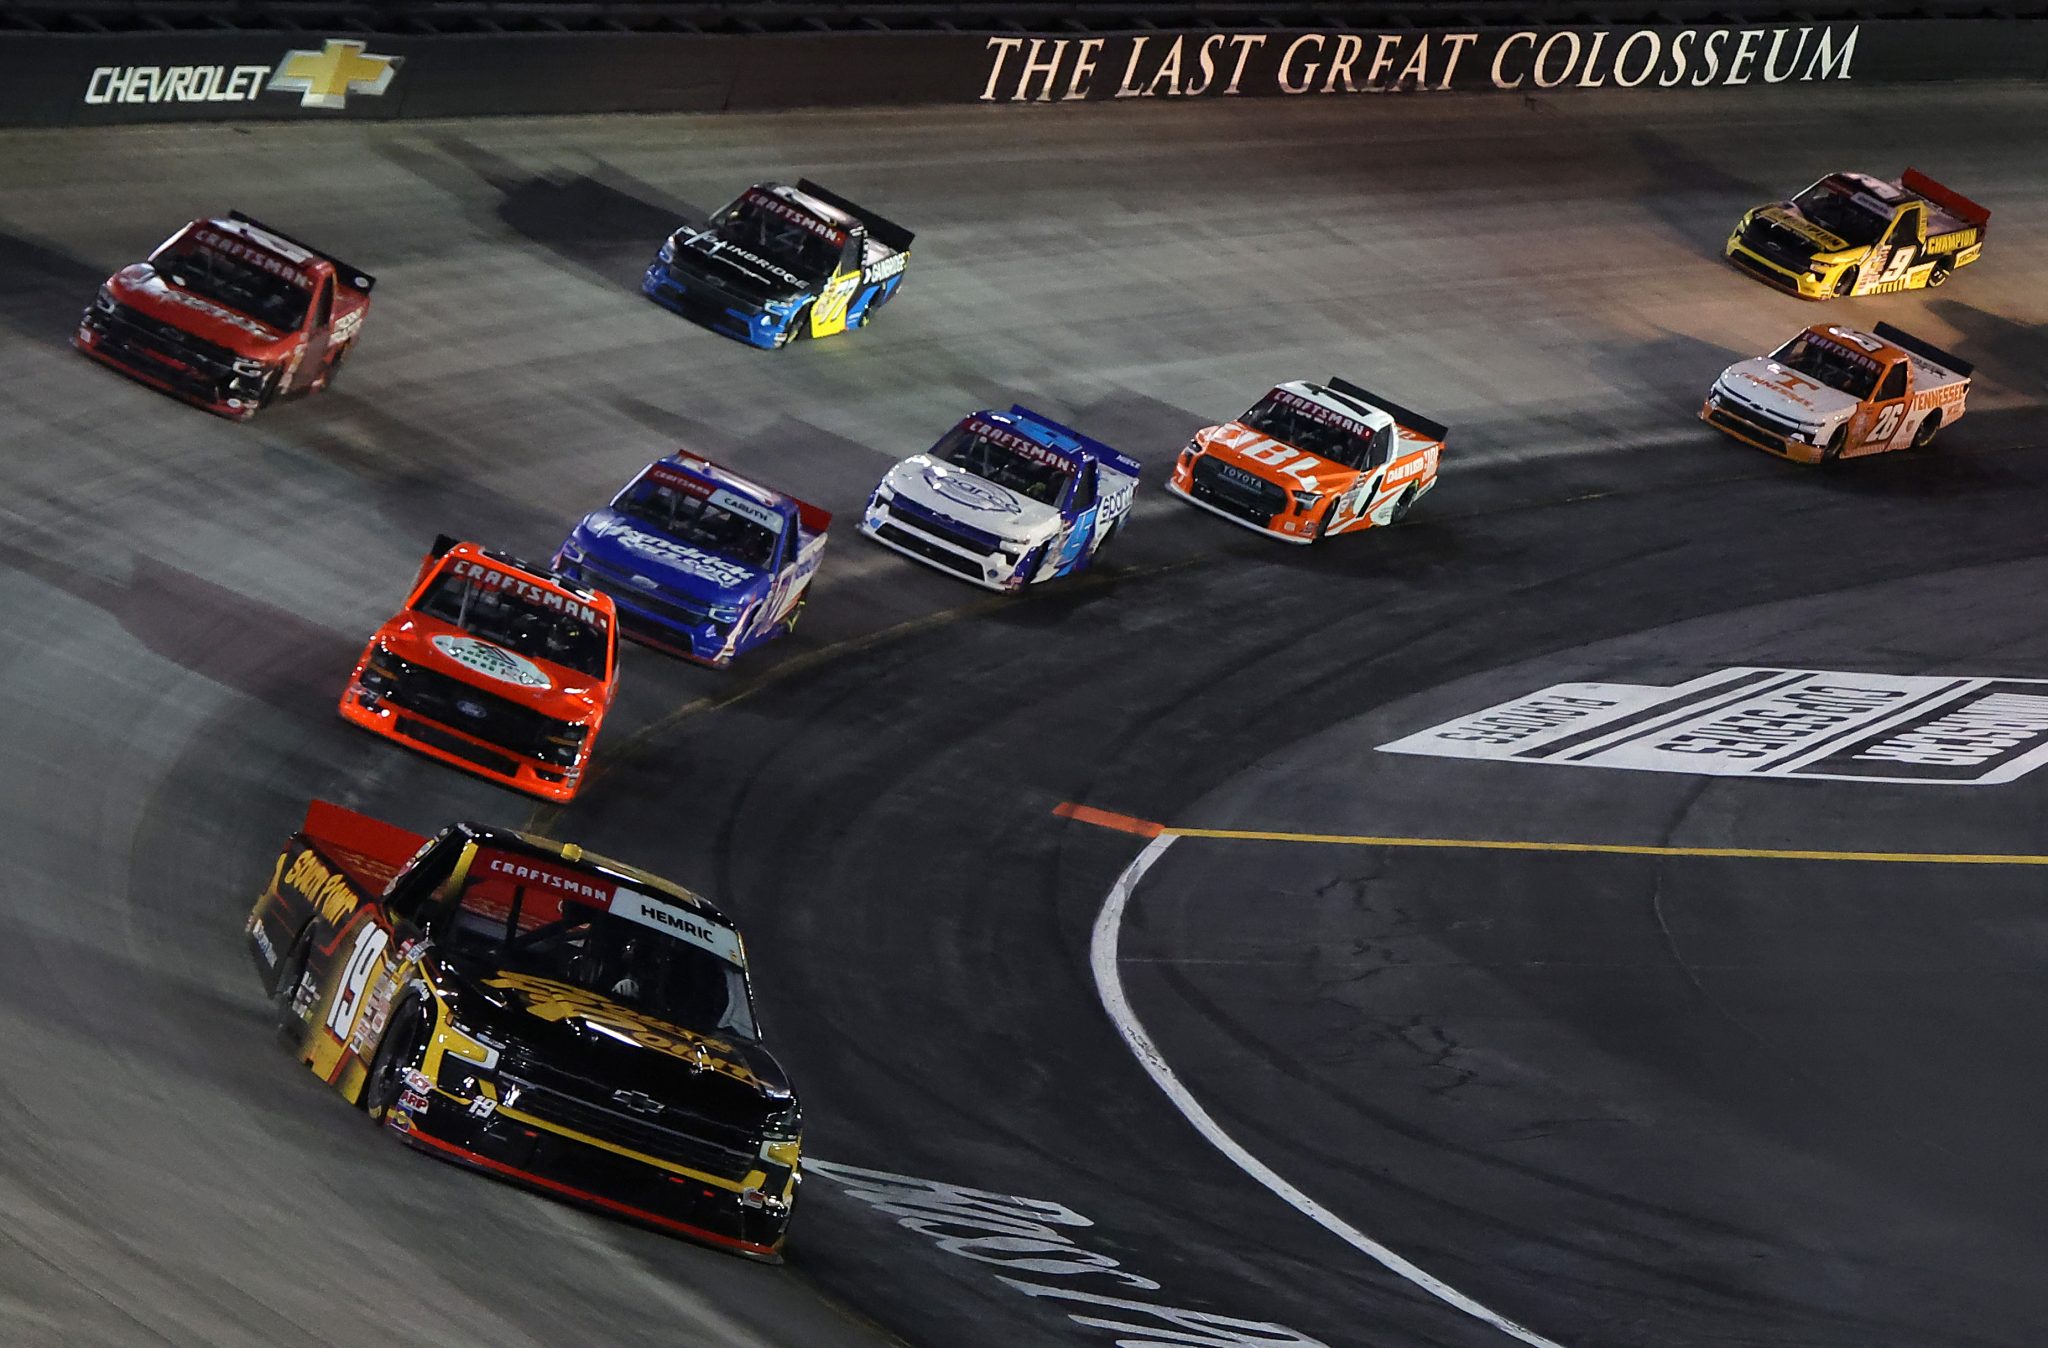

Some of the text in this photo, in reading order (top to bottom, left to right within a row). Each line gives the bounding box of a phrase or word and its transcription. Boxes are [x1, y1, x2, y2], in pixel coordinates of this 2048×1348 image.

[85, 65, 271, 103] CHEVROLET
[979, 24, 1861, 102] THE LAST GREAT COLOSSEUM
[748, 193, 838, 242] CRAFTSMAN
[195, 229, 310, 288] CRAFTSMAN
[1927, 228, 1978, 256] CHAMPION
[1879, 245, 1917, 284] 9
[1804, 333, 1877, 371] CRAFTSMAN
[1273, 390, 1363, 437] CRAFTSMAN
[1912, 383, 1964, 412] TENNESSEE
[1865, 402, 1905, 443] 26
[970, 421, 1069, 473] CRAFTSMAN
[1223, 463, 1264, 490] TOYOTA
[724, 497, 769, 522] CARUTH
[453, 560, 597, 624] CRAFTSMAN
[1432, 695, 1621, 746] PLAYOFFS
[1646, 684, 1914, 760] CUP SERIES
[489, 859, 715, 945] CRAFTSMAN HEMRIC
[326, 920, 390, 1041] 19
[401, 1091, 428, 1112] ARP
[468, 1095, 498, 1119] 19
